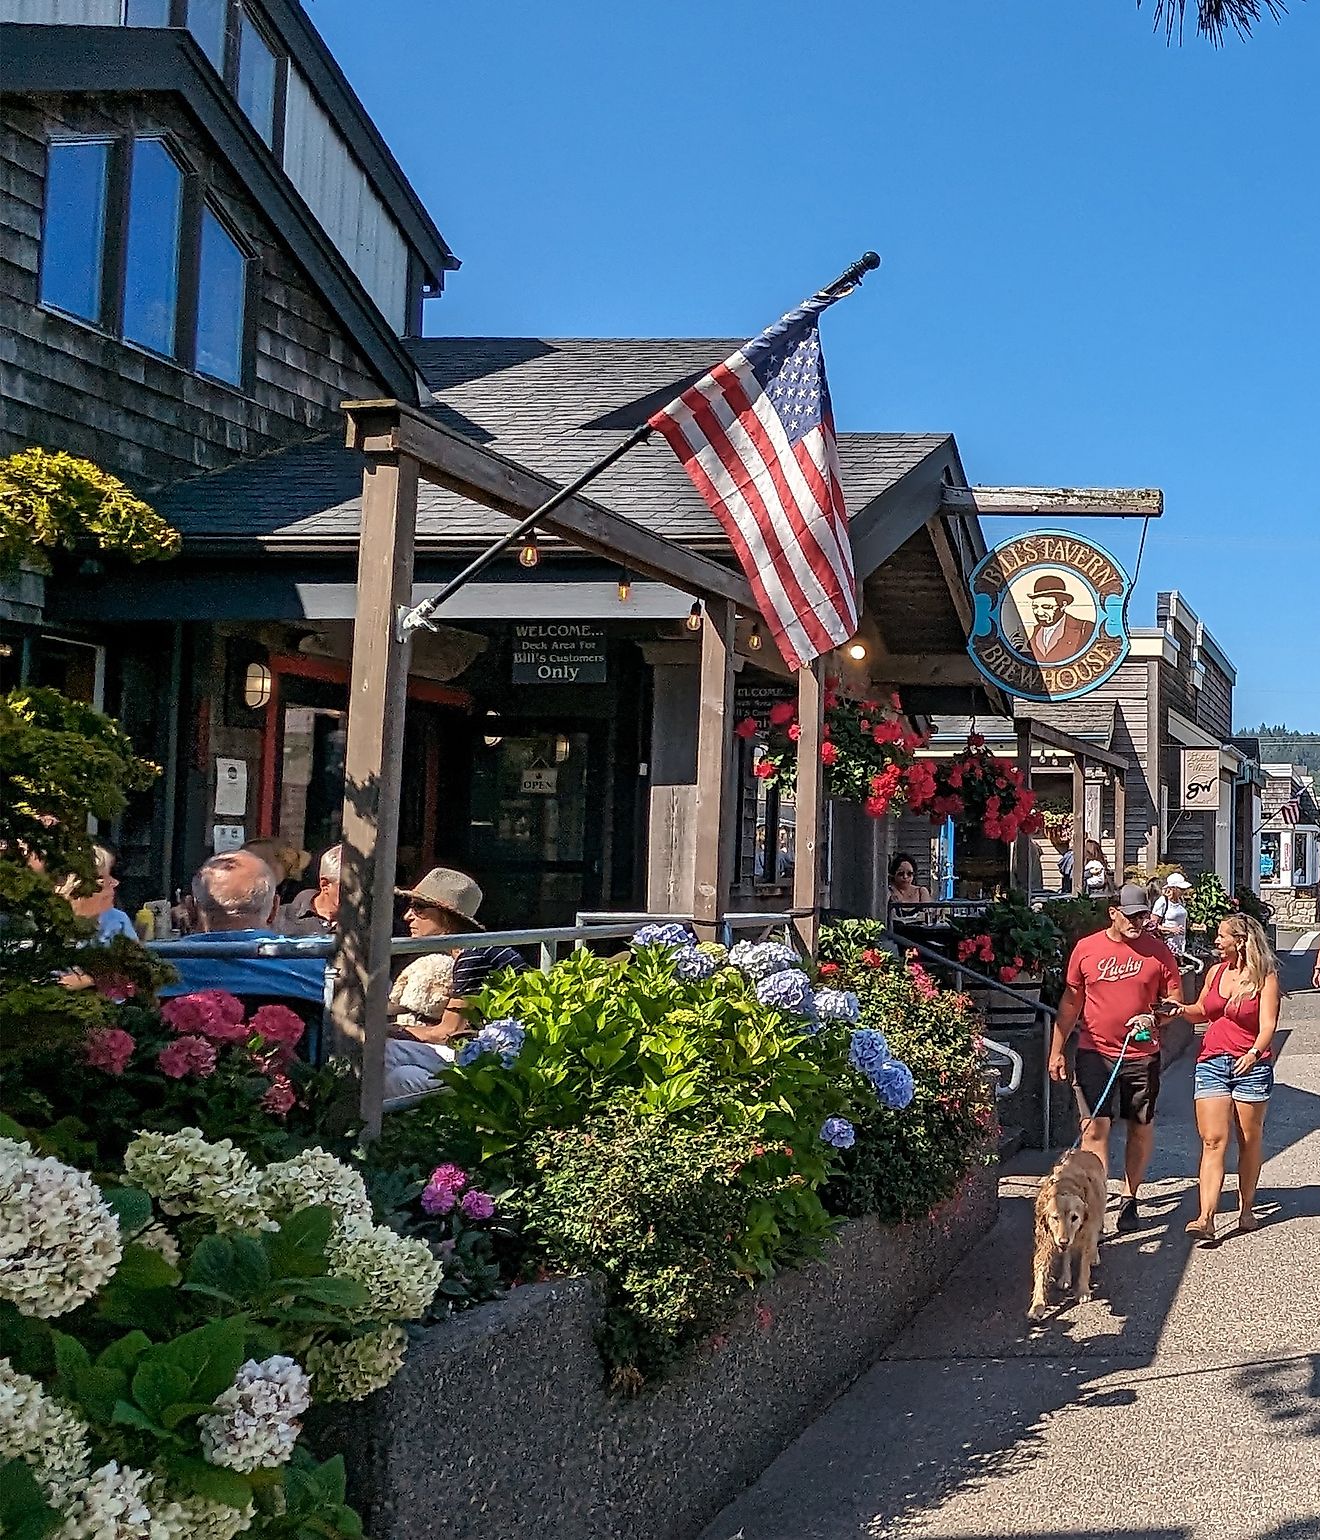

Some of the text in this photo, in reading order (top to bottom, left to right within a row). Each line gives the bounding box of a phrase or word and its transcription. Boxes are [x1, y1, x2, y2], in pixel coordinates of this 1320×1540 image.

[981, 538, 1117, 588] BILL'S TAVERN
[521, 641, 548, 650] Deck
[551, 641, 576, 650] Area
[513, 651, 605, 664] Bill's Customers
[537, 665, 580, 682] Only
[523, 781, 553, 790] OPEN
[1096, 956, 1143, 982] Lucky
